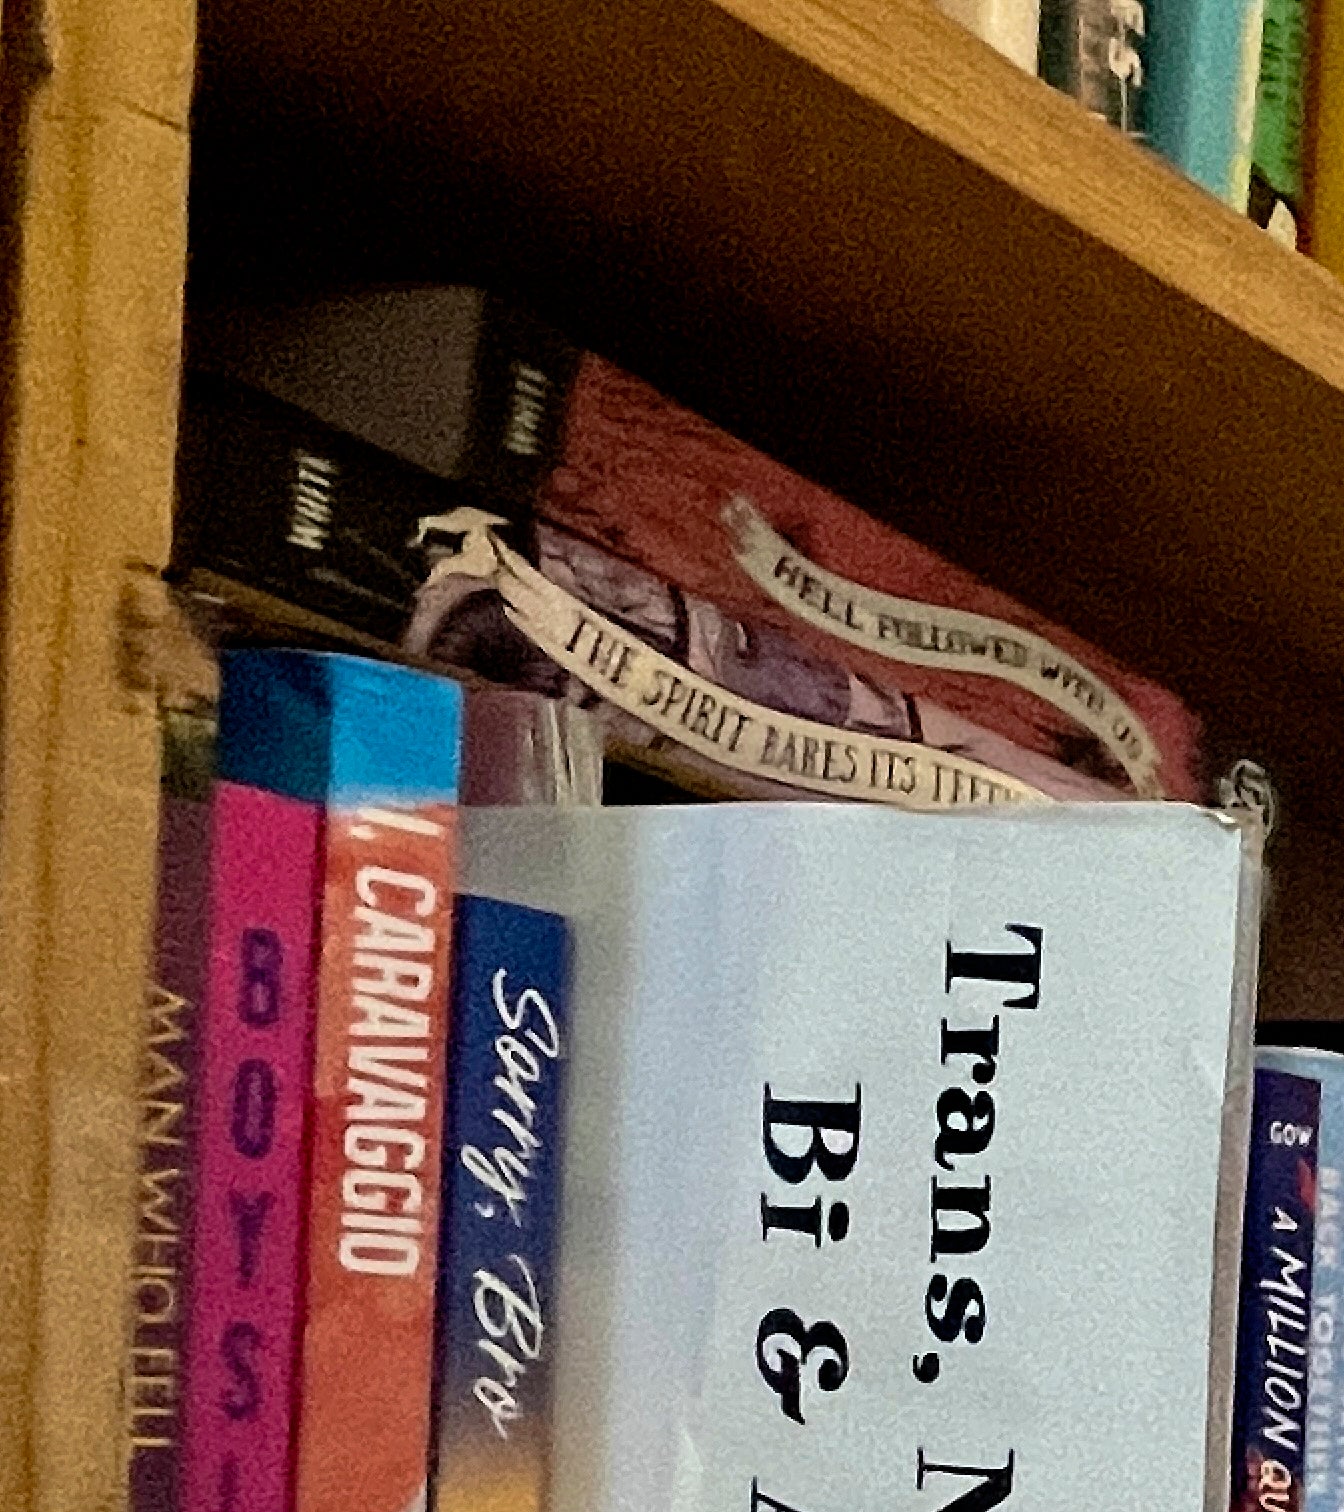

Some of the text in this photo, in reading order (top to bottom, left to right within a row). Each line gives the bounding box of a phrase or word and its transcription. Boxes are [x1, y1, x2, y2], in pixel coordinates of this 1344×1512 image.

[772, 555, 864, 632] HELL
[877, 613, 1029, 667] FOLLOWED
[564, 613, 634, 690] THE
[642, 669, 752, 752] SPIRIT
[758, 725, 860, 784] BARES
[870, 751, 917, 795] ITS
[348, 806, 446, 842] I,
[338, 866, 438, 1277] CARAVAGGIO
[911, 923, 1045, 1386] Trans,
[460, 967, 561, 1441] Sorry, Bro
[761, 1081, 863, 1249] Bi
[1271, 1206, 1299, 1233] A
[755, 1308, 850, 1424] &
[1258, 1247, 1309, 1452] MILLION
